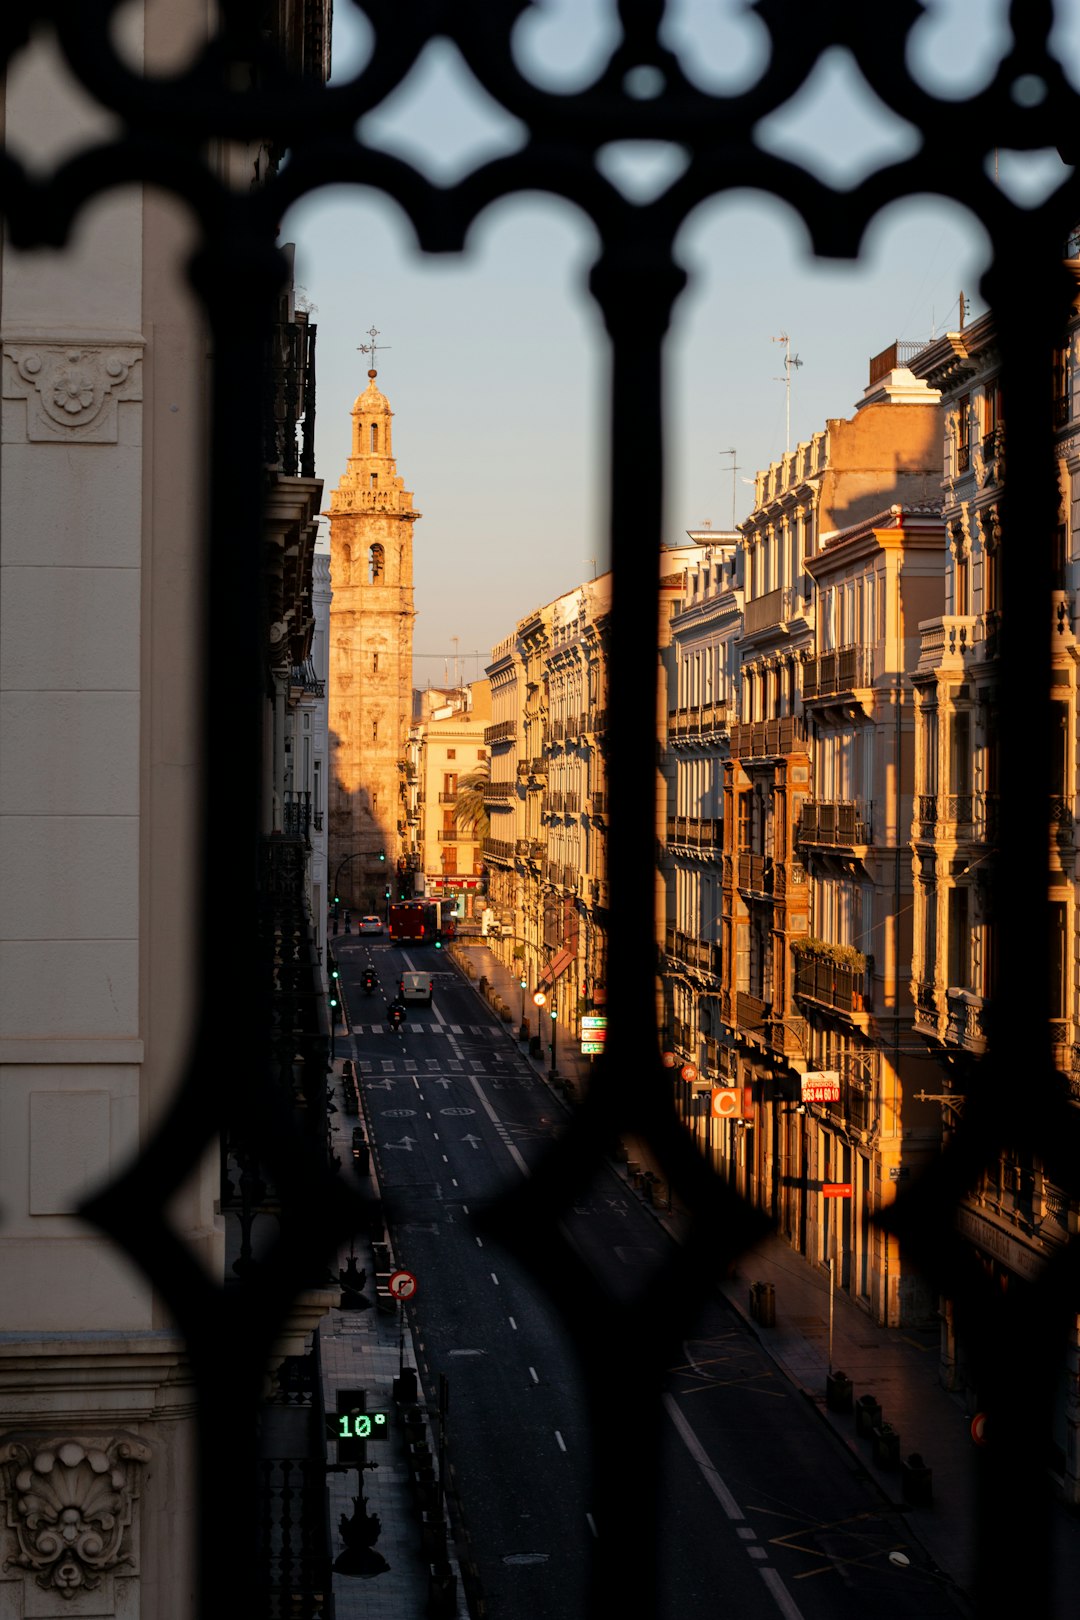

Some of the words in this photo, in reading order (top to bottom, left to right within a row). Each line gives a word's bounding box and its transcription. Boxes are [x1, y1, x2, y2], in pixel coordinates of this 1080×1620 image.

[802, 1089, 814, 1101] 963
[815, 1089, 824, 1100] 44
[832, 1088, 839, 1100] 10
